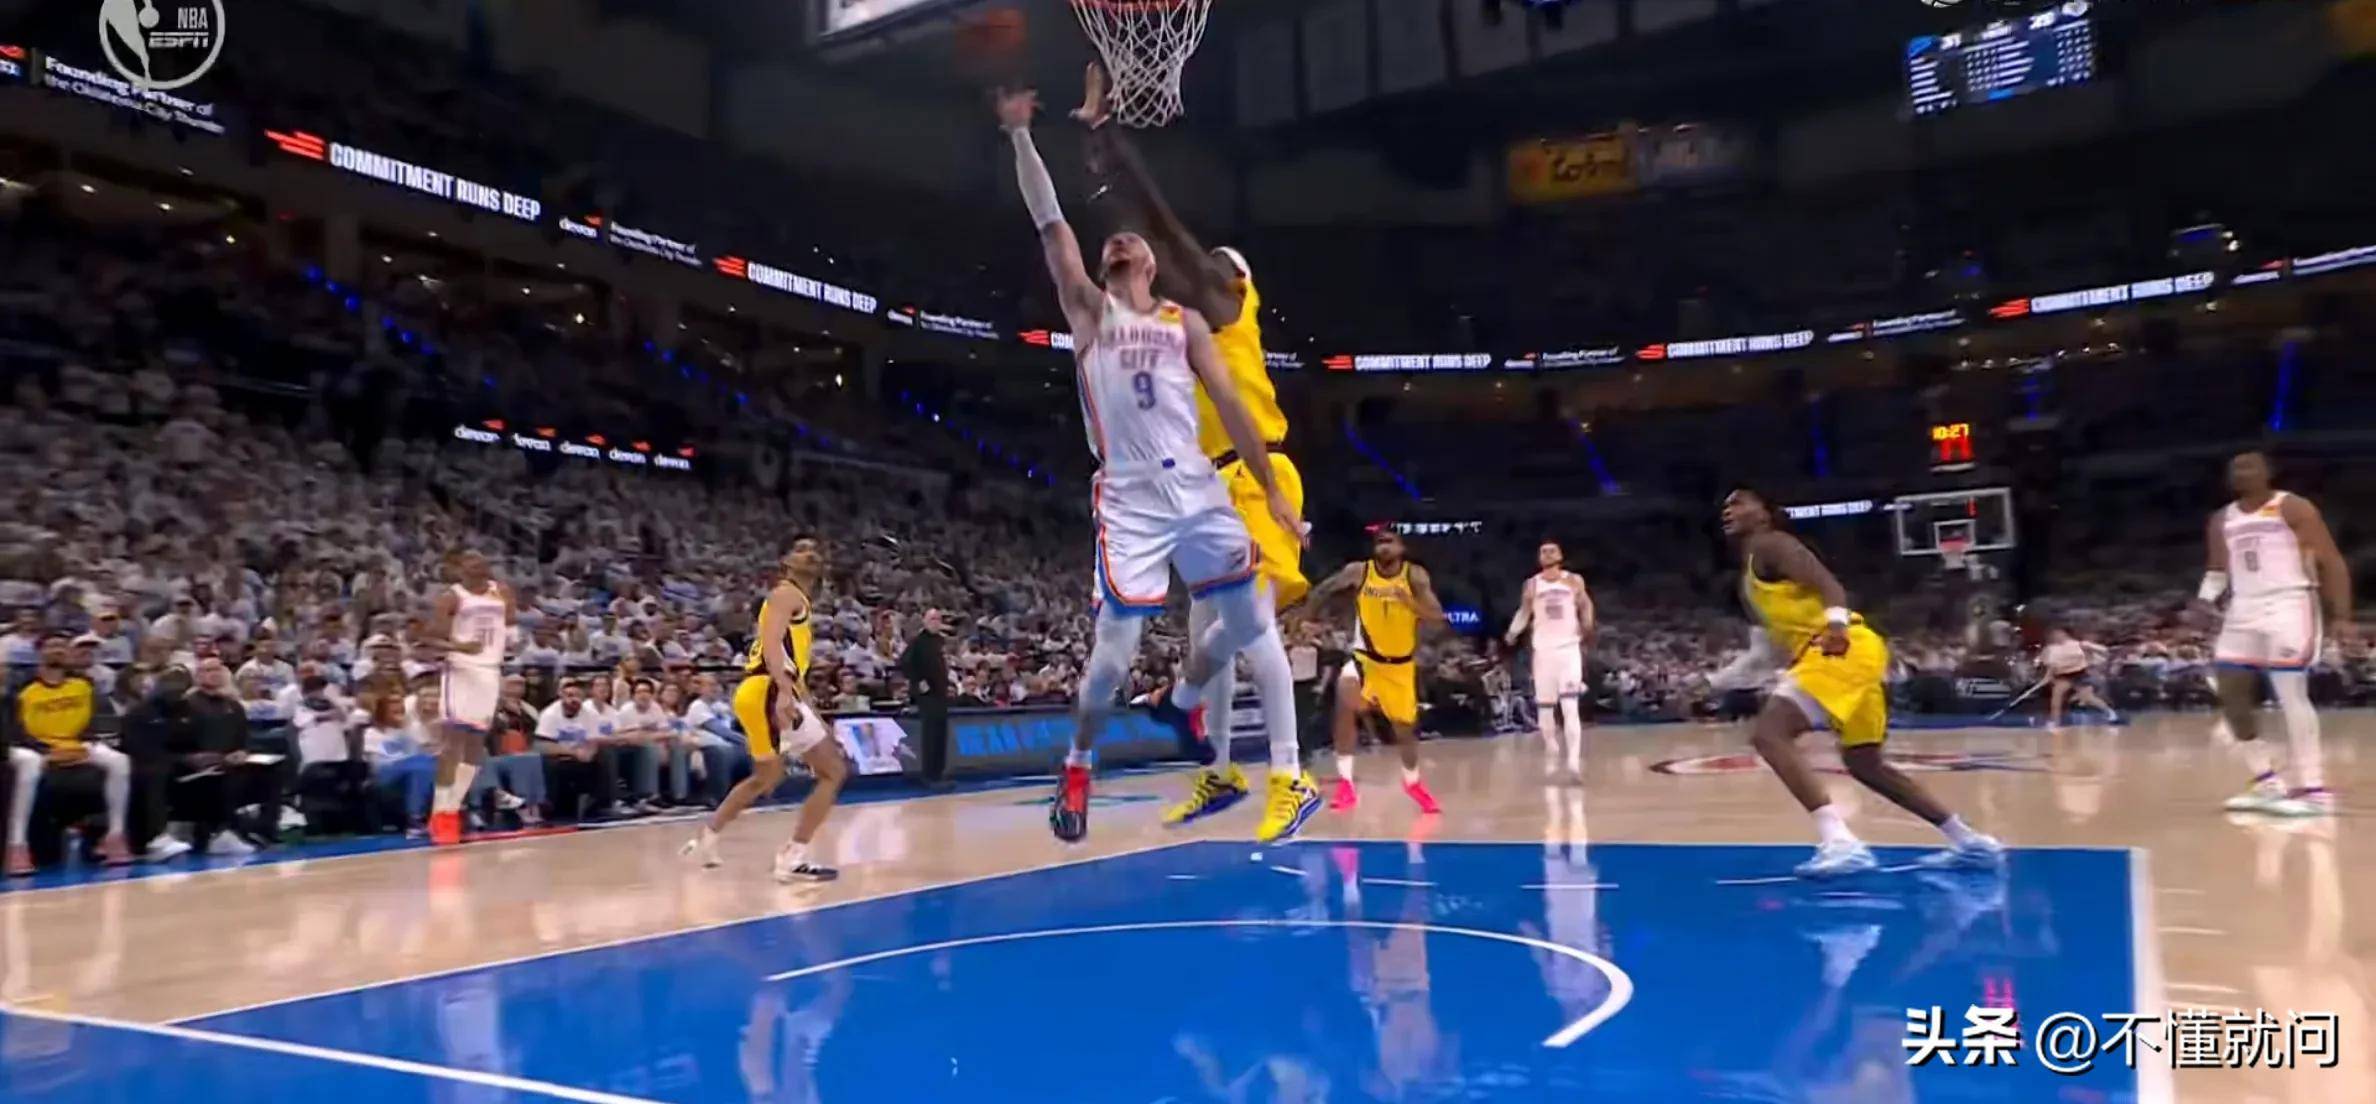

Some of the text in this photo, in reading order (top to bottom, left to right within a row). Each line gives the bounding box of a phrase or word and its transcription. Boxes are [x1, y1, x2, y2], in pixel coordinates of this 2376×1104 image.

[330, 142, 541, 221] COMMITMENT RUNS DEEP
[748, 261, 821, 302] COMMITMENT
[852, 292, 877, 314] DEEP
[1132, 371, 1156, 411] 9
